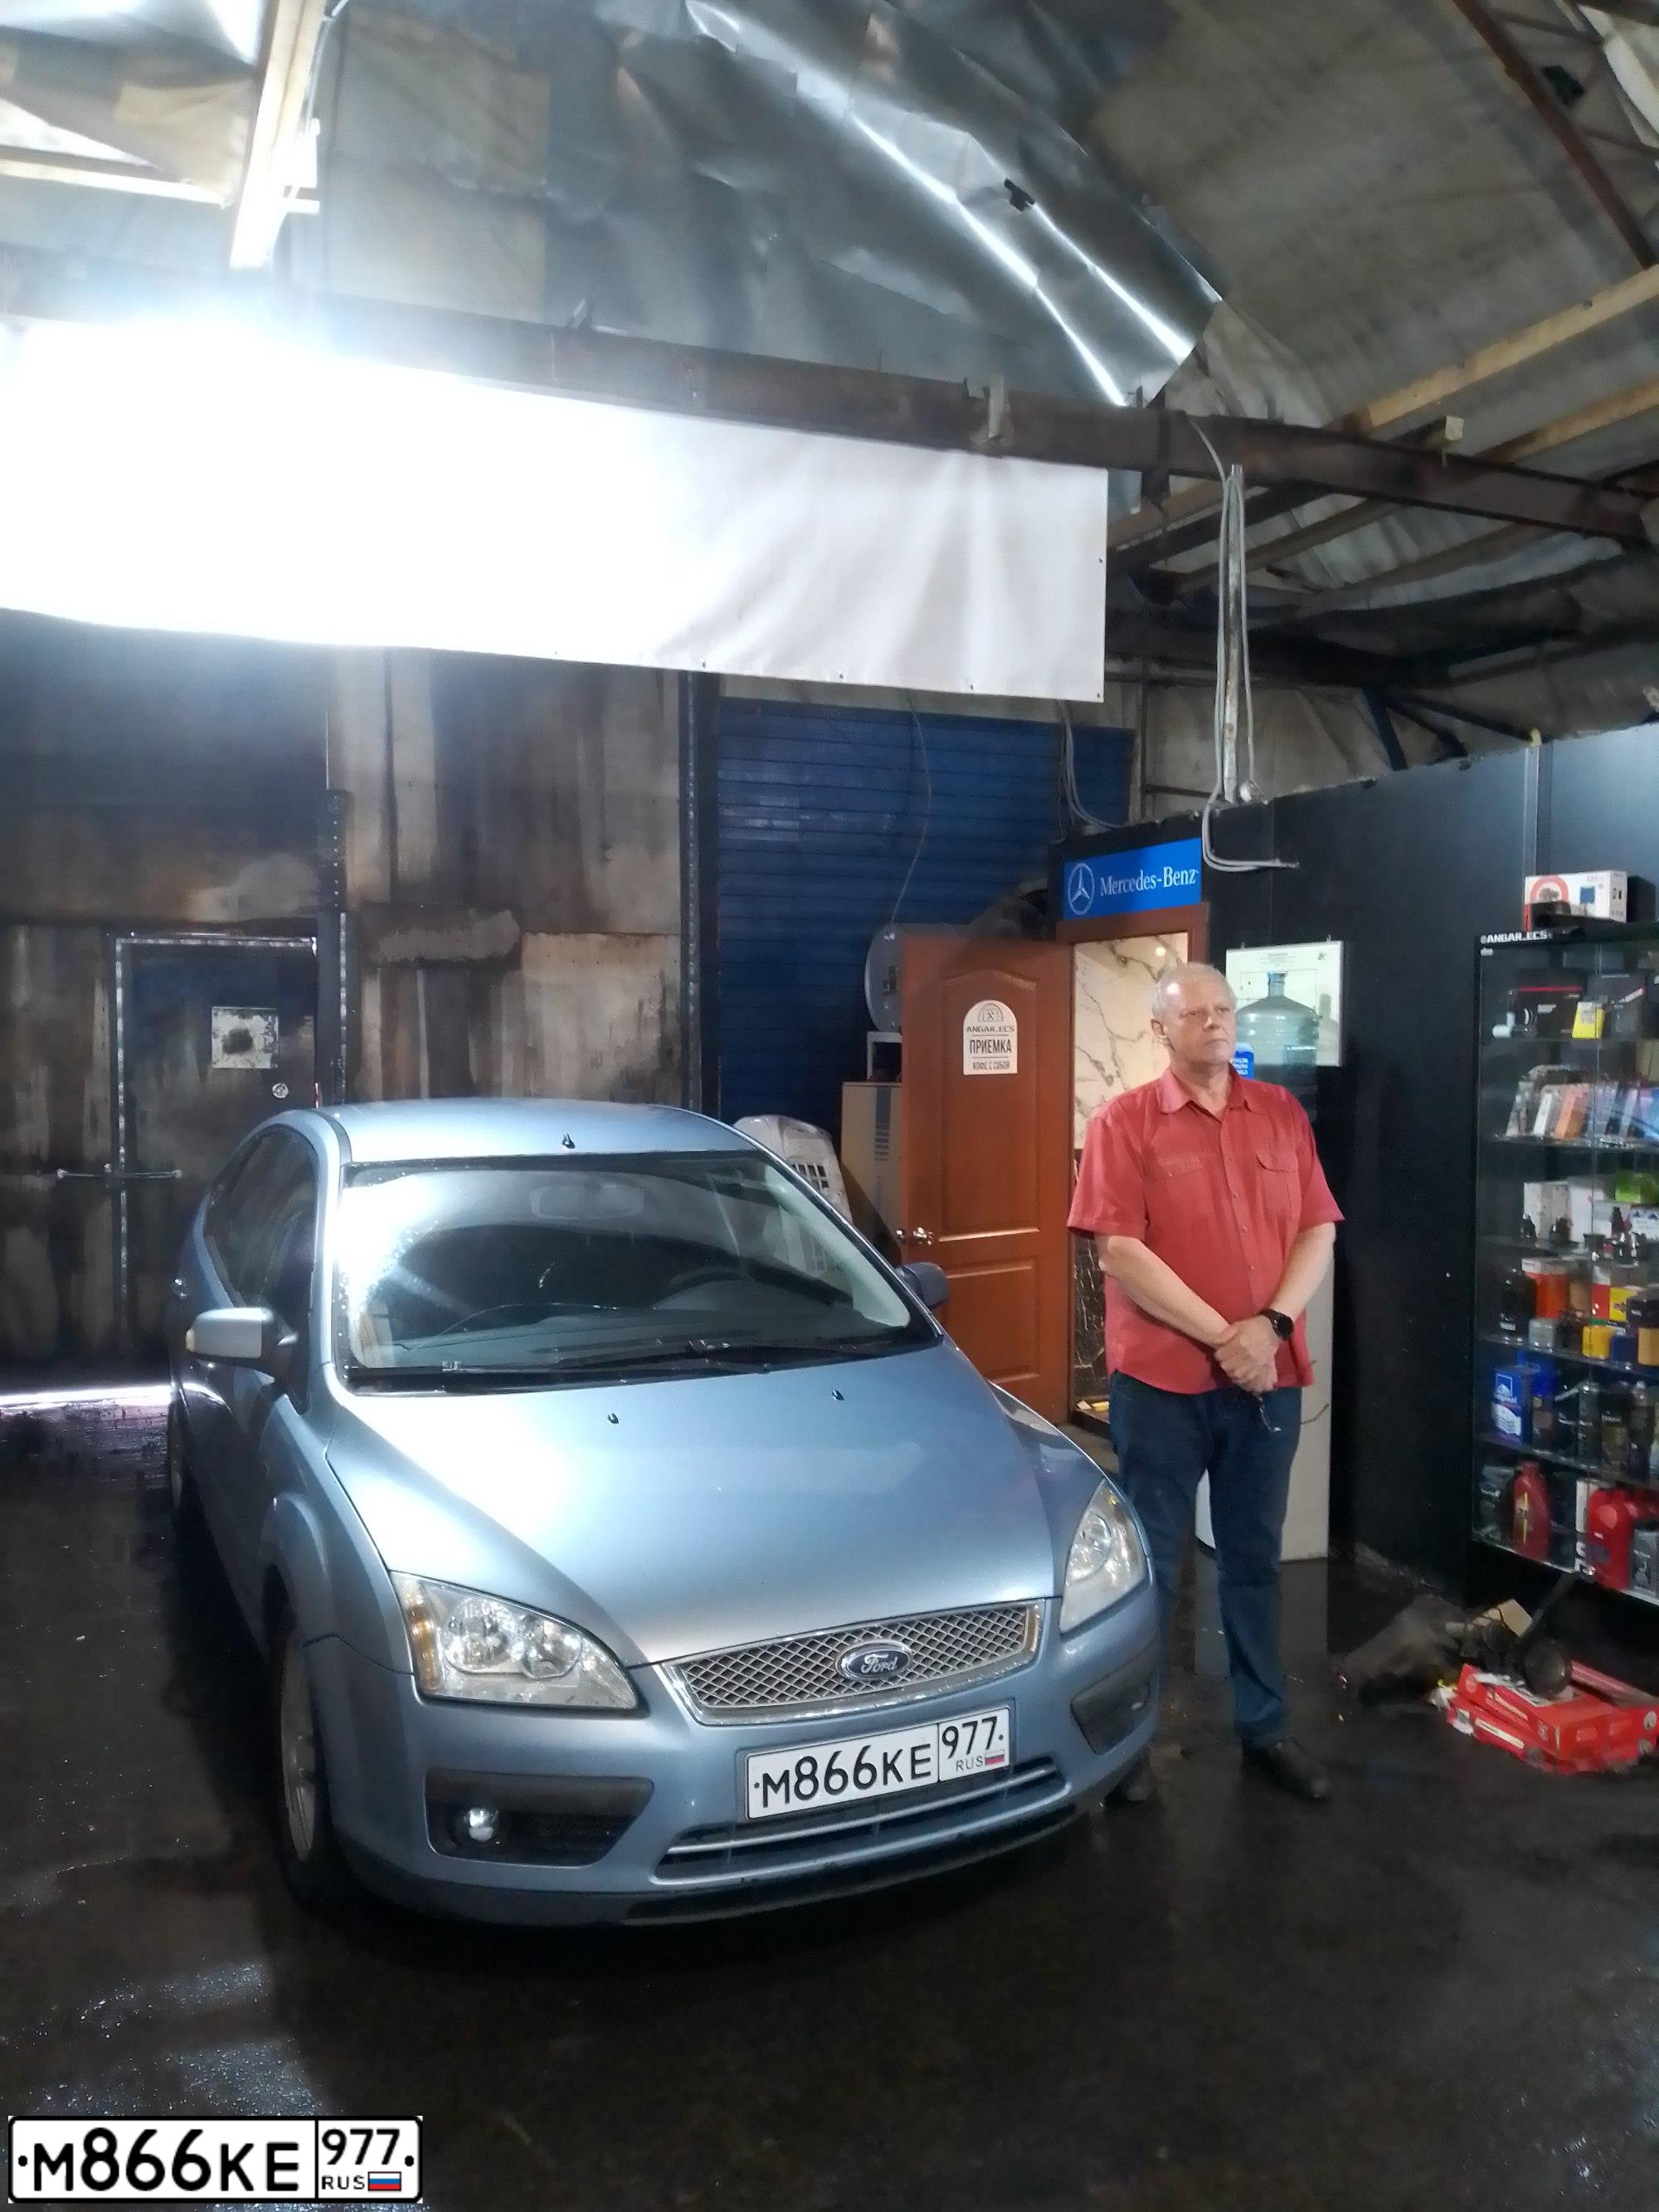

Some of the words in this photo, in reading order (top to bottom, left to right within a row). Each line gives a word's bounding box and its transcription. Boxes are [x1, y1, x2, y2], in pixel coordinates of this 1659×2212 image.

[1100, 865, 1195, 897] Mercedes-Benz
[970, 1039, 1012, 1055] ПРИЕМКА
[860, 1653, 898, 1674] Ford
[941, 1715, 999, 1760] 977
[956, 1756, 985, 1772] RUS
